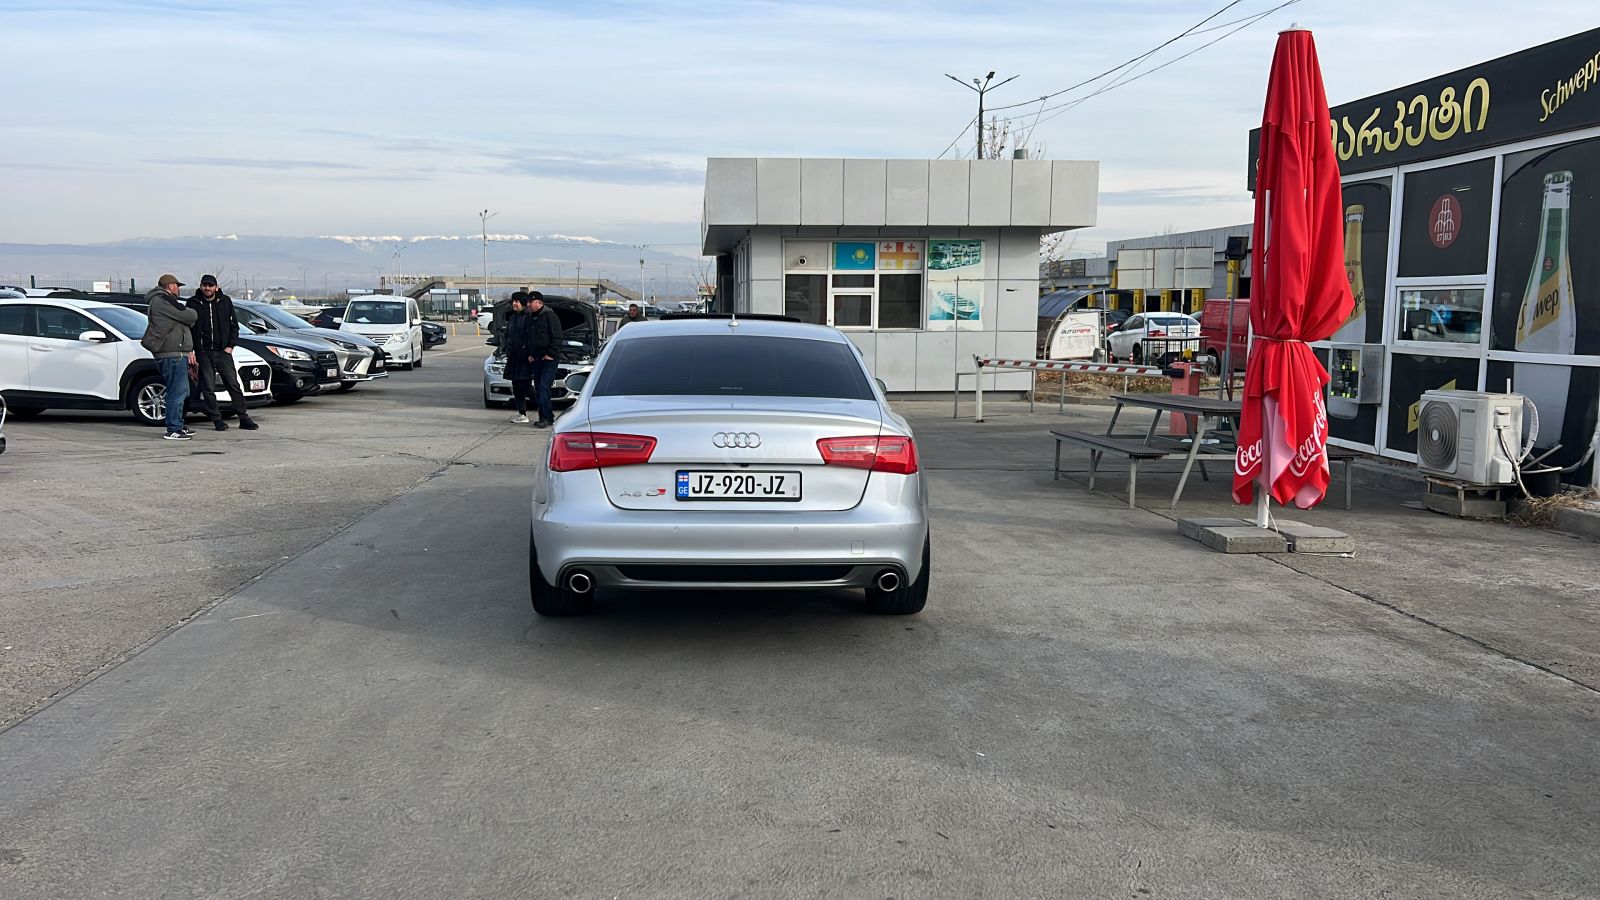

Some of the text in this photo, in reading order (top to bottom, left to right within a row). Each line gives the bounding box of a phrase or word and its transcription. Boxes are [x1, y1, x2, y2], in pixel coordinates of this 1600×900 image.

[1437, 232, 1452, 242] 1783
[679, 475, 785, 494] GE JZ-920-JZ
